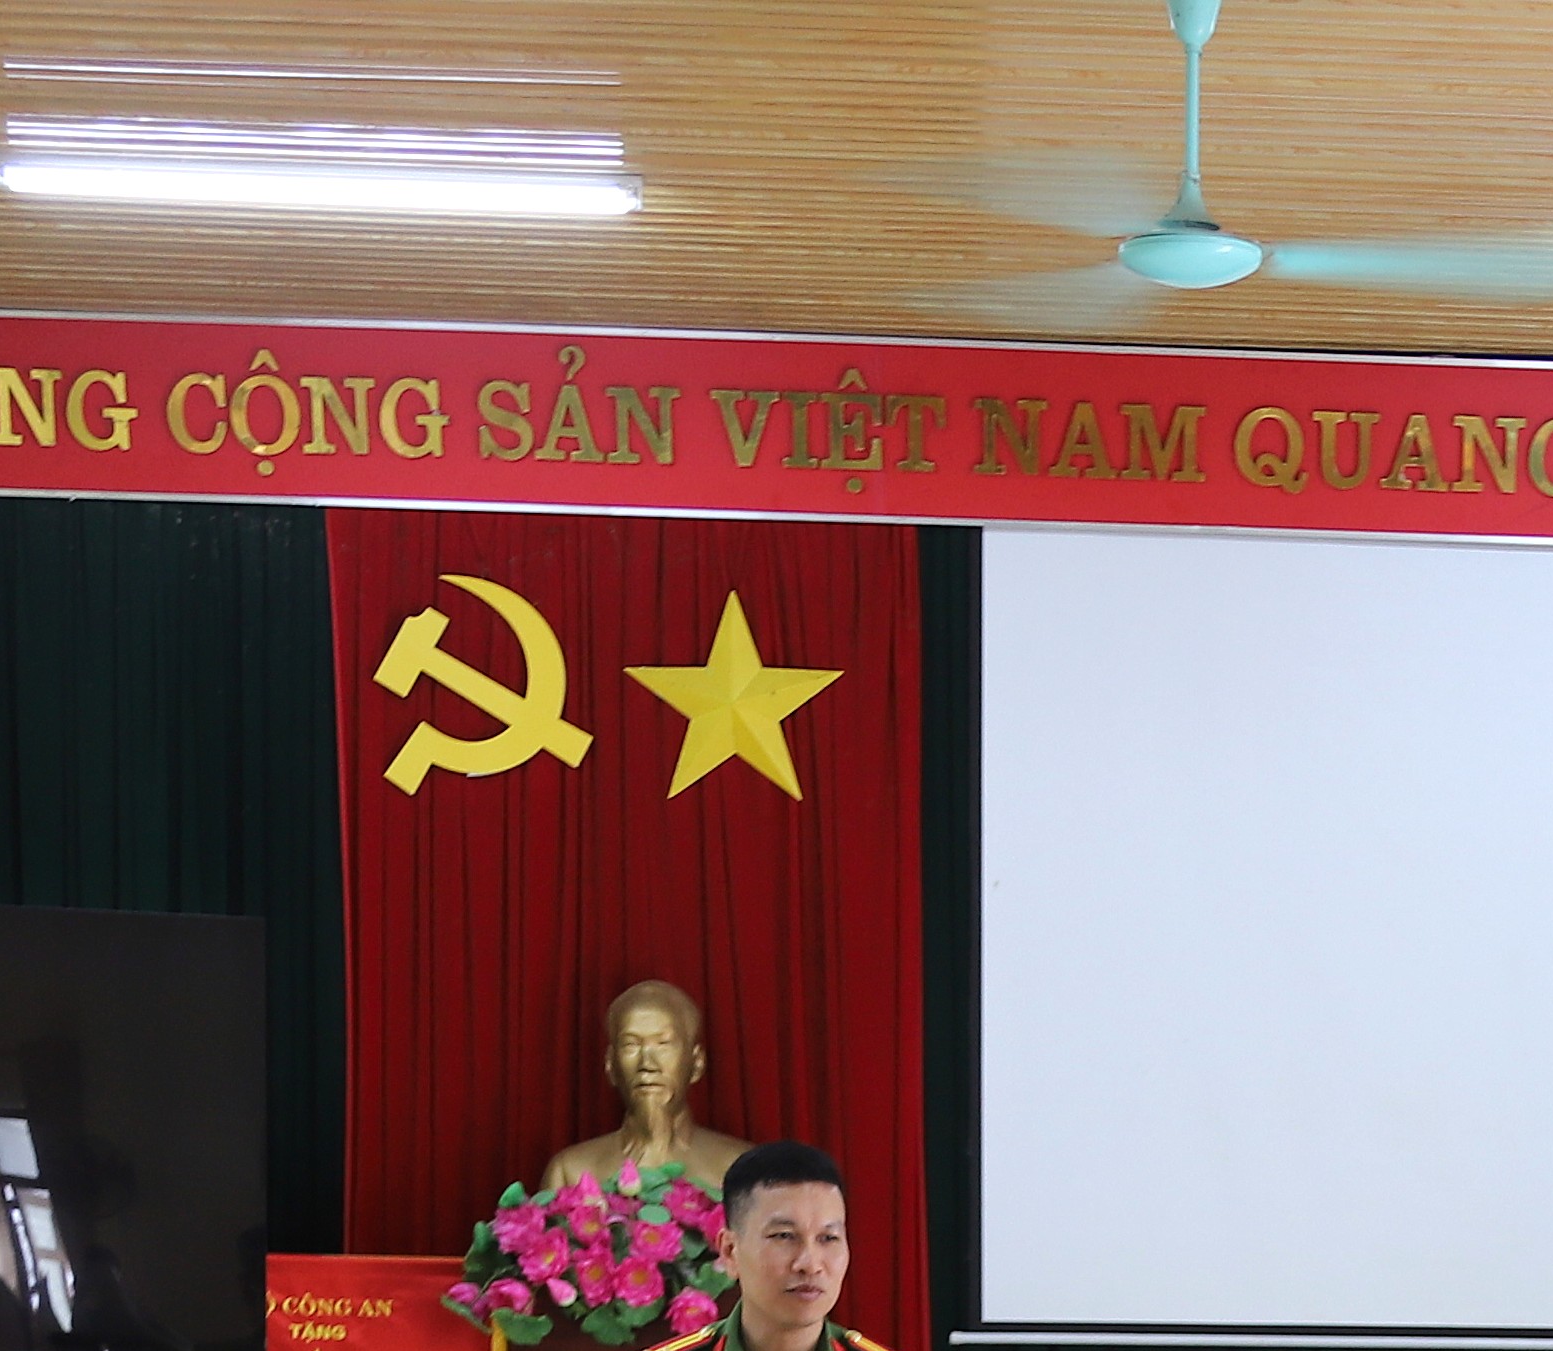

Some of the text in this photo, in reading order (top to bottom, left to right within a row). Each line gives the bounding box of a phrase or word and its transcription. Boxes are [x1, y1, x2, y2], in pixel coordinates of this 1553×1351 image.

[166, 349, 450, 476] CỘNG
[477, 345, 681, 467] SẢN
[709, 367, 946, 494] VIỆT
[972, 398, 1206, 482] NAM
[282, 1291, 353, 1317] CÔNG
[357, 1298, 394, 1318] AN
